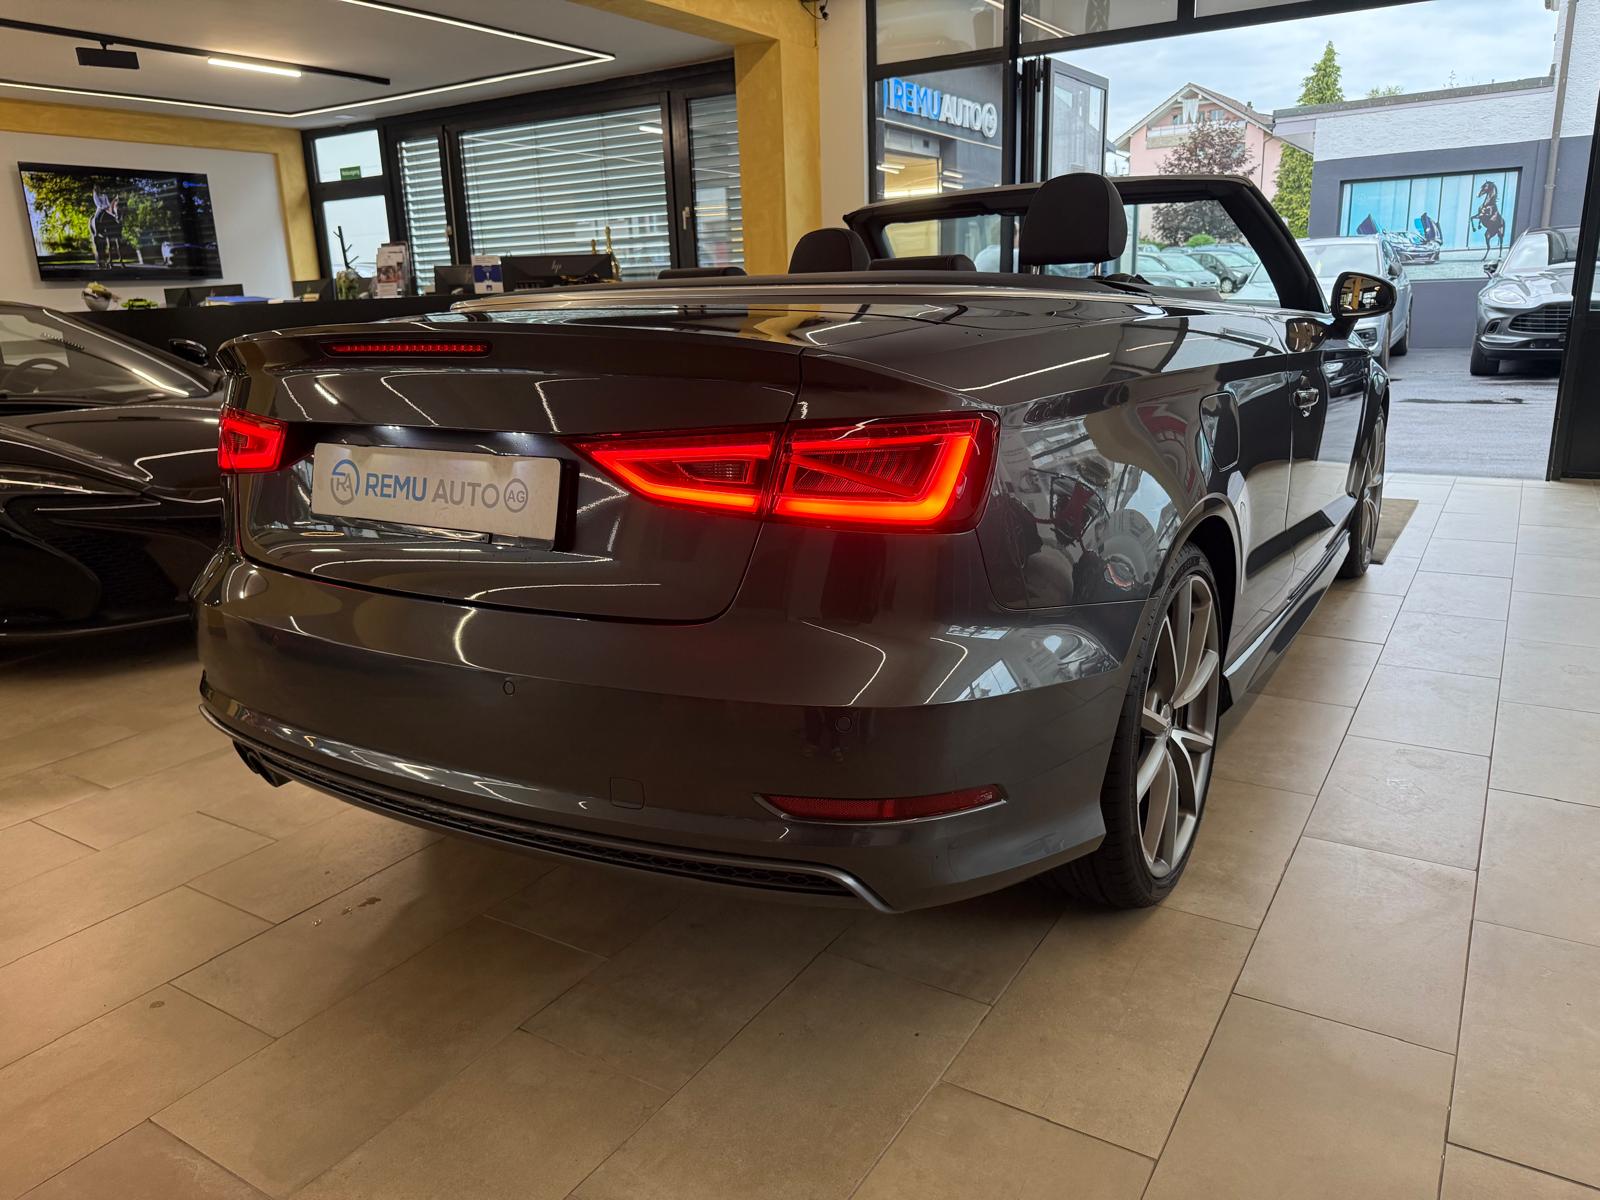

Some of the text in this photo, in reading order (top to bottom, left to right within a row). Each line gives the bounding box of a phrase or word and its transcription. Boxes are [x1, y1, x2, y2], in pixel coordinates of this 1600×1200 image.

[889, 77, 941, 120] REMU
[940, 94, 982, 131] AUTO
[365, 473, 427, 501] REMU
[432, 479, 500, 509] AUTO
